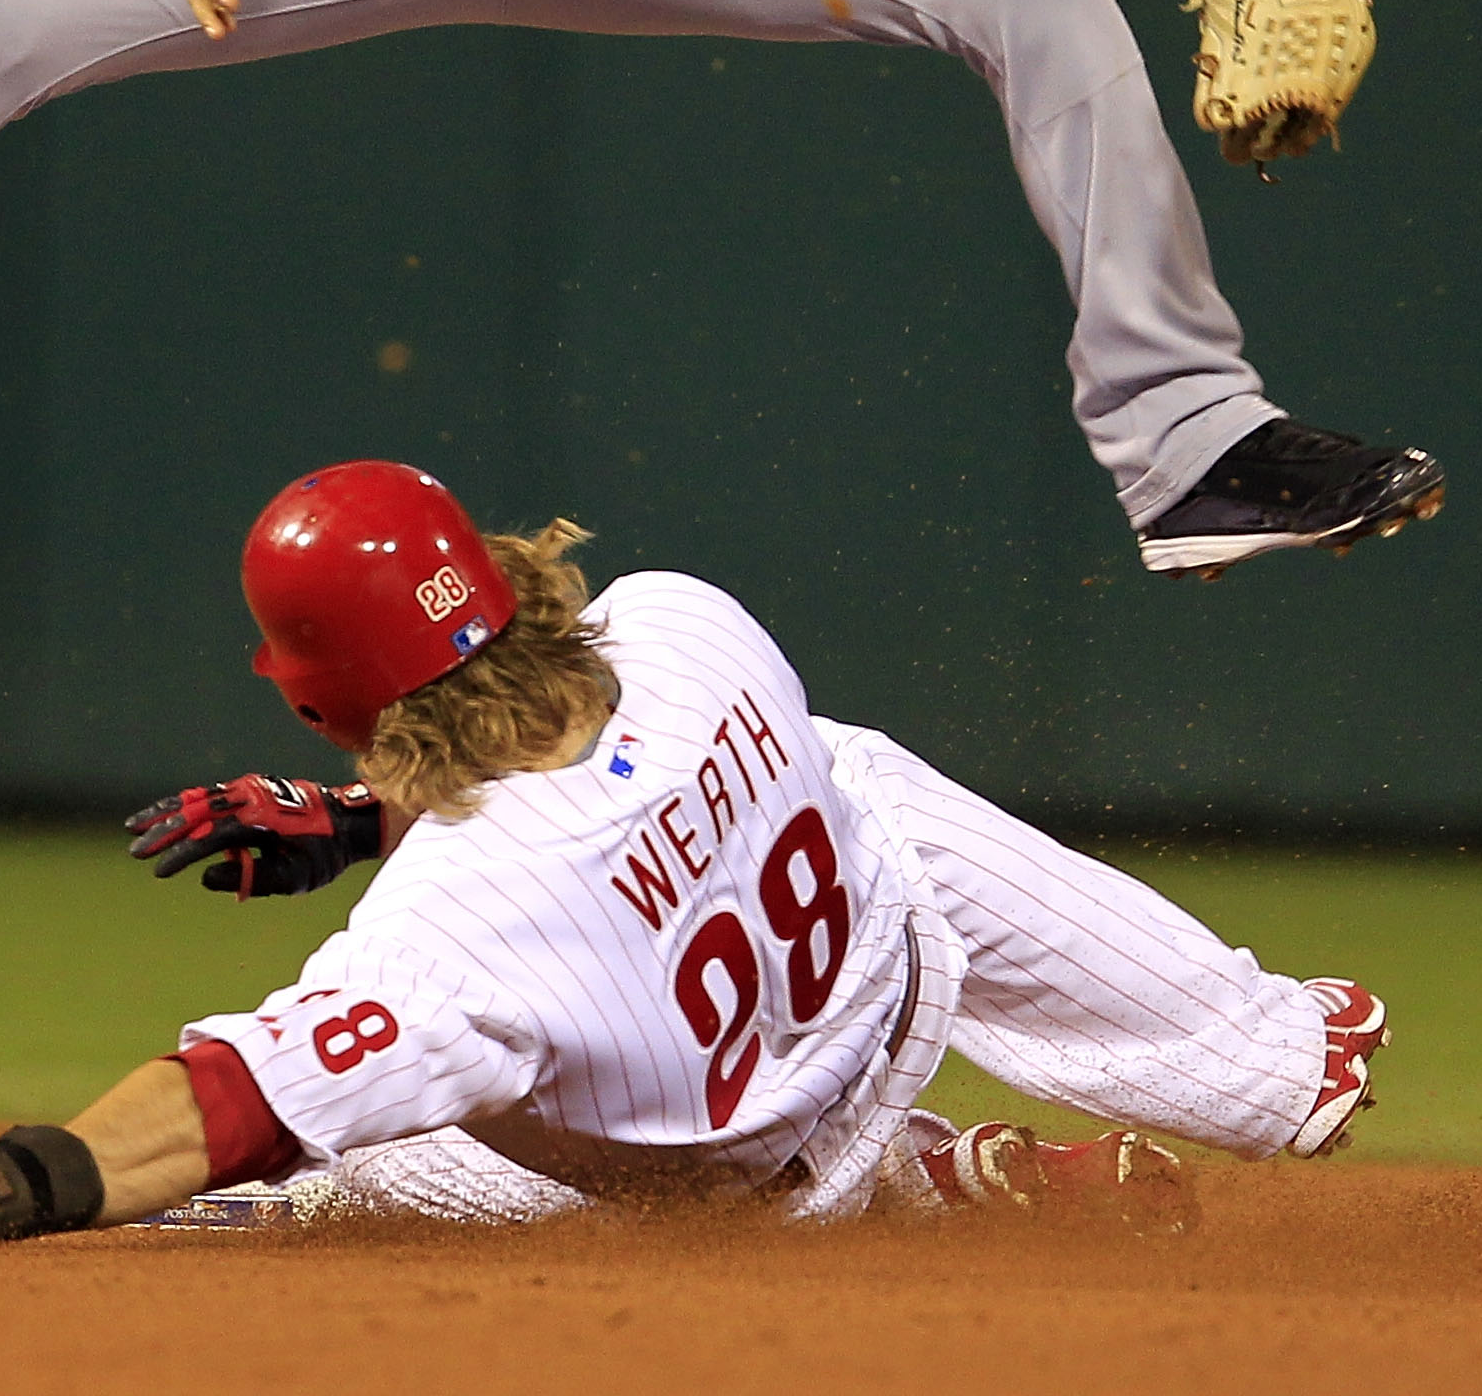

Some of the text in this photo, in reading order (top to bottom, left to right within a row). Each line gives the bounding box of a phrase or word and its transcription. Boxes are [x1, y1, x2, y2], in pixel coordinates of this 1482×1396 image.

[415, 565, 470, 623] 28
[611, 688, 791, 934] WERTH
[674, 805, 851, 1132] 28
